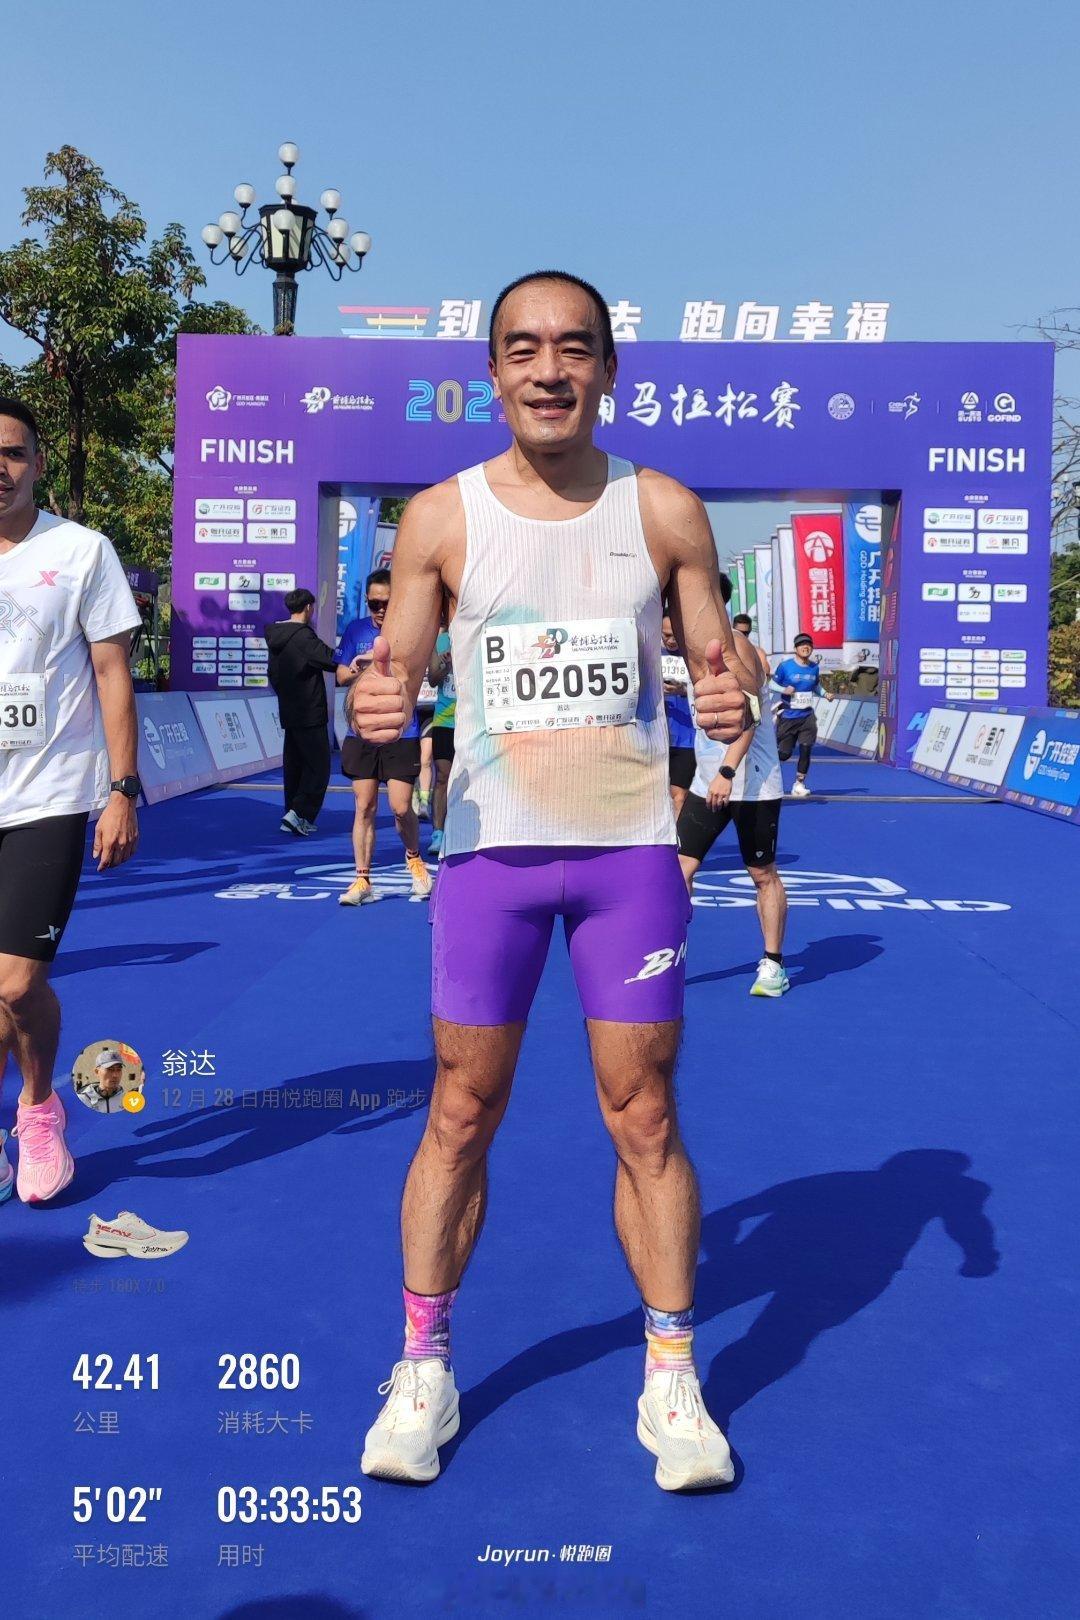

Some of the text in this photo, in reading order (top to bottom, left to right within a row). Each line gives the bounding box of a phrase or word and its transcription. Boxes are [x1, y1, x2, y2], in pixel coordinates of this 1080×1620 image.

[680, 299, 890, 342] 跑向幸福
[405, 379, 506, 423] 202
[987, 414, 1022, 422] GOFIND
[200, 438, 294, 464] FINISH
[928, 447, 1026, 472] FINISH
[486, 635, 505, 664] B
[515, 661, 629, 701] 02055
[0, 704, 37, 728] 30
[690, 896, 1012, 912] OFIND
